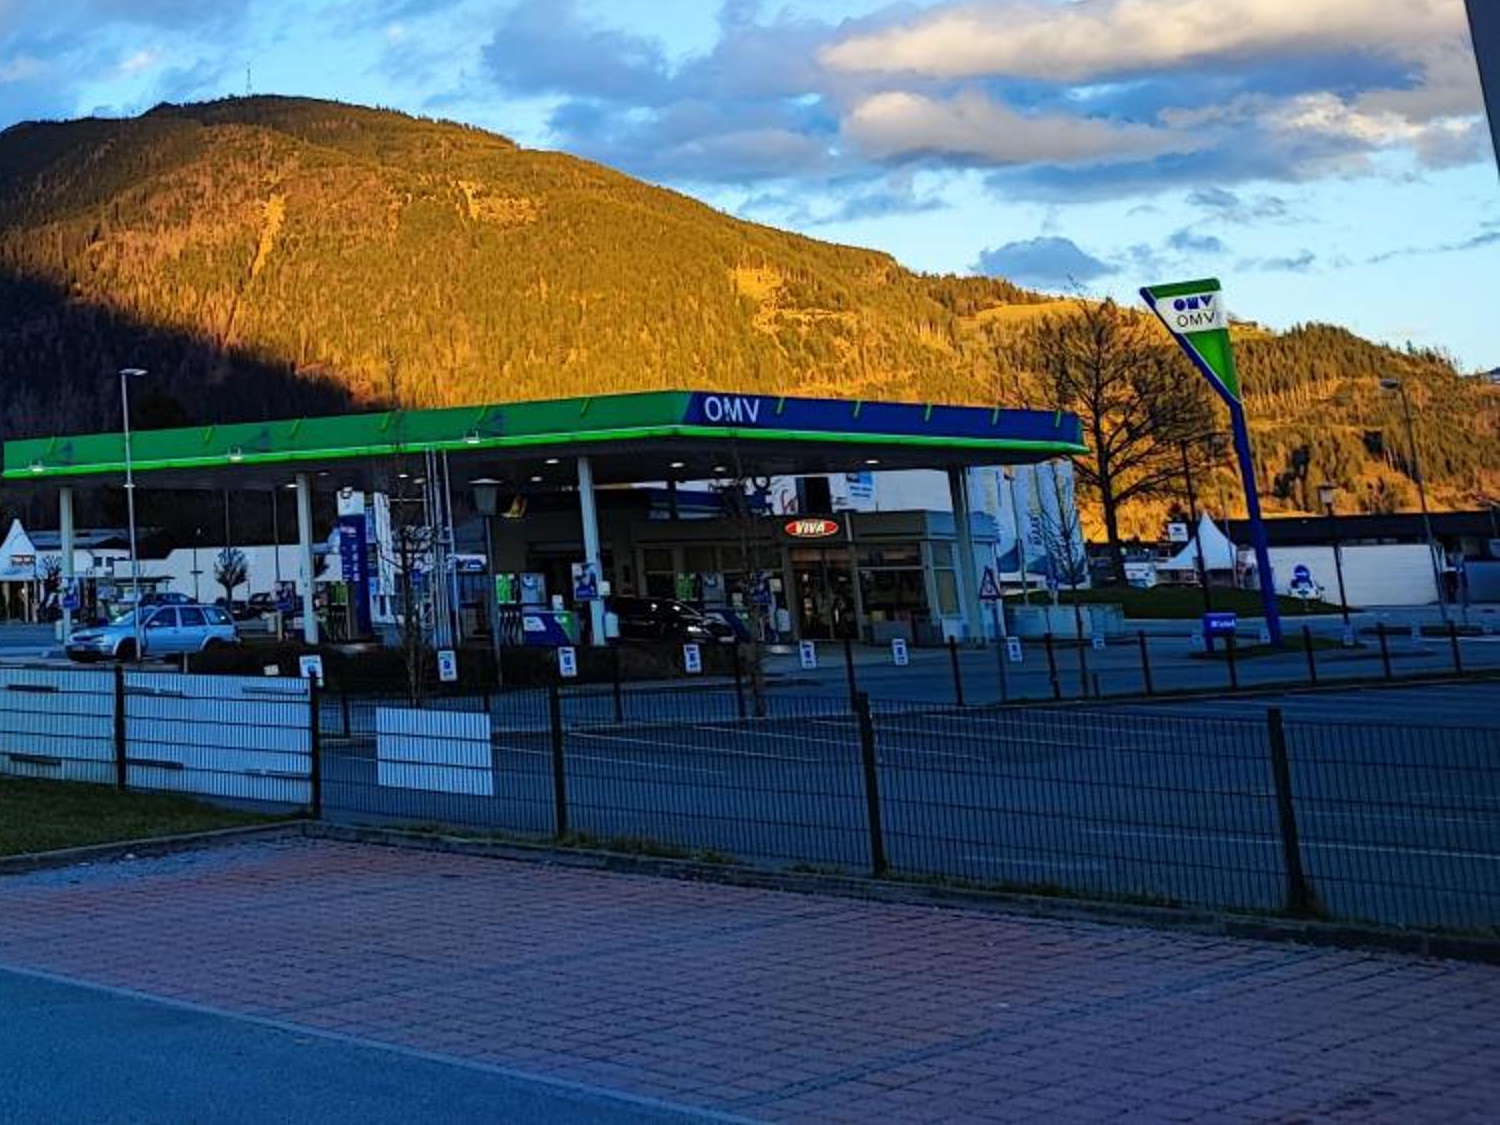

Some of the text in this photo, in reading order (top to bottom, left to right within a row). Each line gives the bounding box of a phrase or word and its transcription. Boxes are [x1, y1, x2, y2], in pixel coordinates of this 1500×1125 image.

[1177, 310, 1215, 328] OMV
[705, 396, 760, 423] OMV
[796, 521, 826, 535] VIVA
